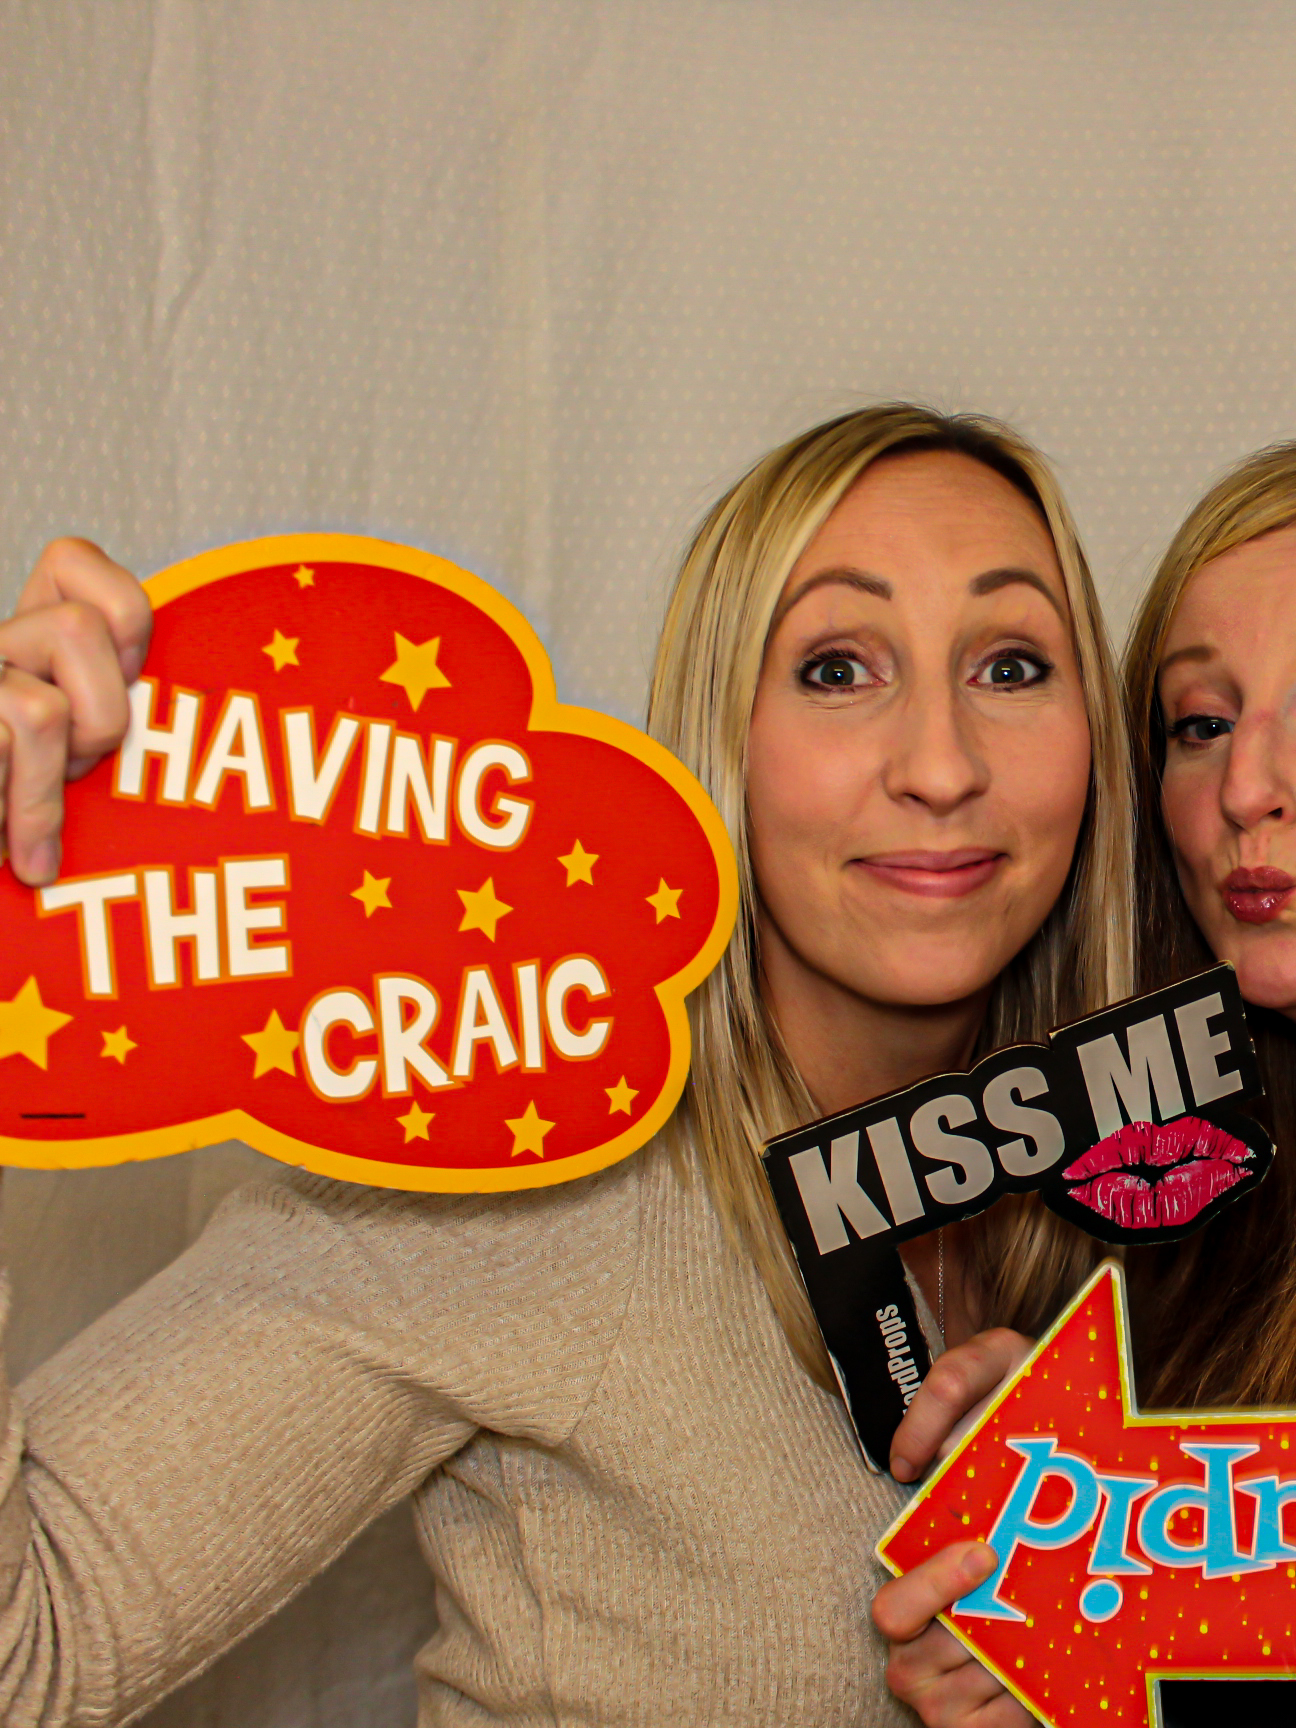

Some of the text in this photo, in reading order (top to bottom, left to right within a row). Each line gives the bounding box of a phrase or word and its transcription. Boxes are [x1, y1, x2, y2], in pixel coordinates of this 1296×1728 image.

[118, 680, 531, 848] HAVING
[41, 859, 288, 994] THE
[304, 958, 610, 1100] CRAIC
[789, 992, 1245, 1256] KISS ME
